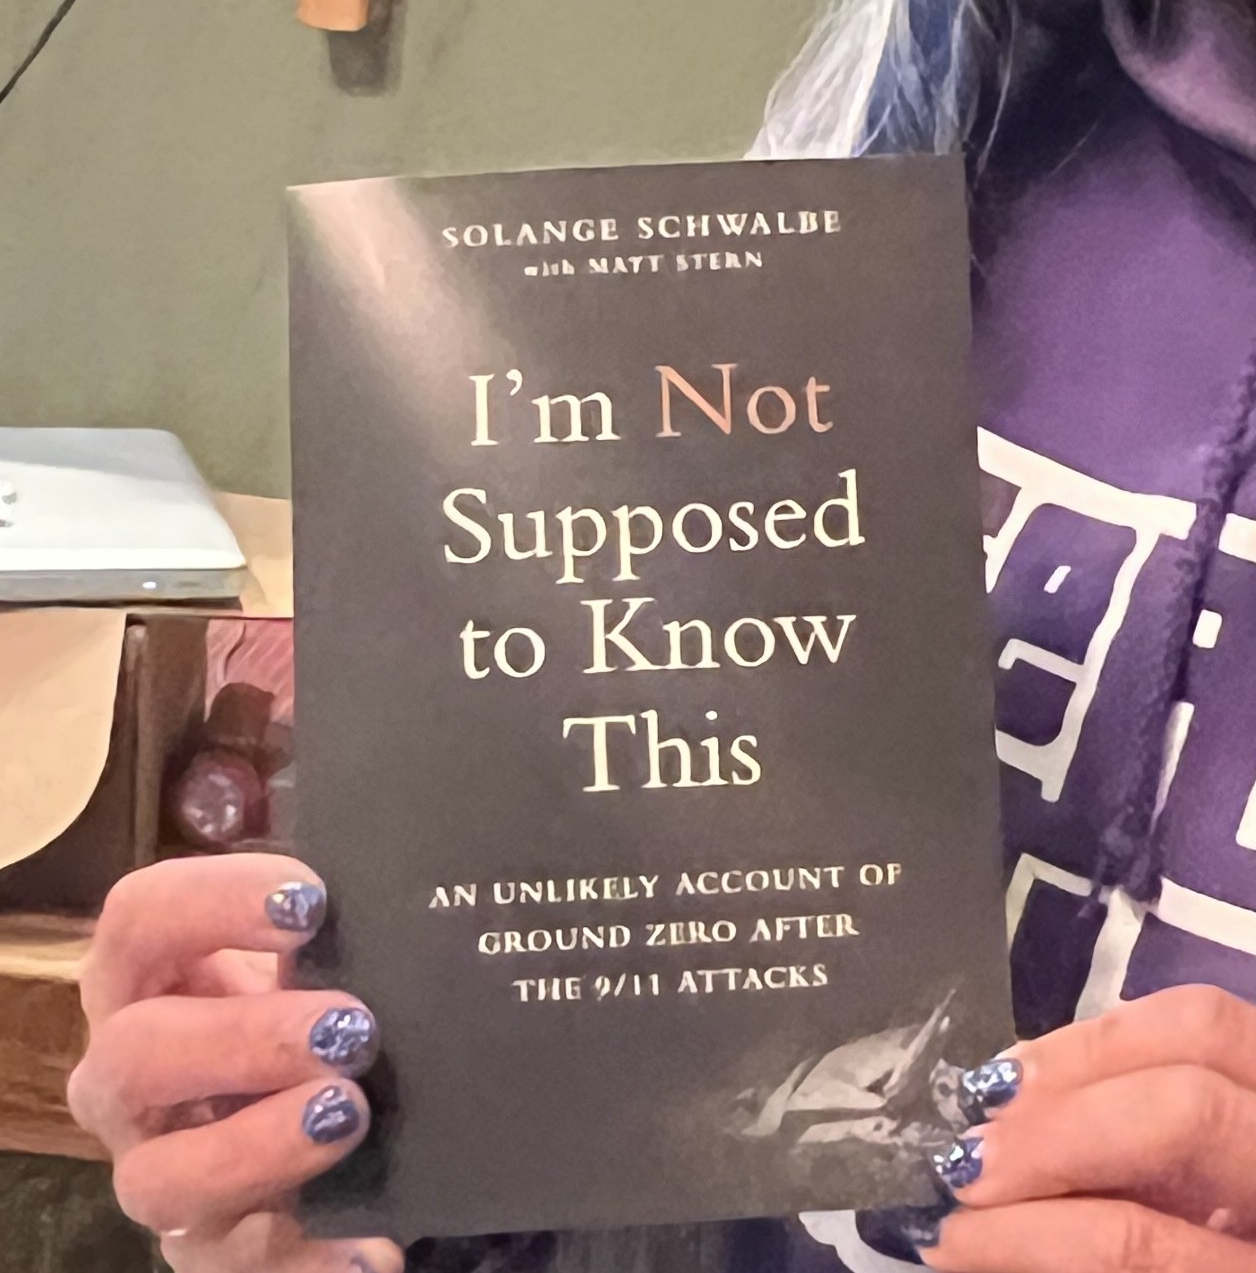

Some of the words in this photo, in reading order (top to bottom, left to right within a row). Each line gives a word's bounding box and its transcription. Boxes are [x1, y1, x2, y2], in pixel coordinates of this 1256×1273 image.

[441, 218, 619, 248] SOLANGE
[637, 209, 842, 240] SCHWALBE
[588, 253, 664, 274] MATT
[675, 250, 763, 272] STERN
[654, 363, 834, 438] Not
[442, 468, 866, 585] Supposed
[458, 619, 546, 680] to
[579, 596, 857, 674] Know
[562, 709, 762, 793] This
[428, 883, 477, 909] AN
[492, 874, 659, 905] UNLIKELY
[675, 865, 845, 896] ACCOUNT
[859, 862, 902, 887] OF
[477, 924, 631, 956] GROUND
[645, 919, 737, 947] ZERO
[749, 913, 860, 943] AFTER
[511, 976, 582, 1003] THE
[592, 972, 660, 1002] 9/11
[677, 963, 829, 994] ATTACKS
